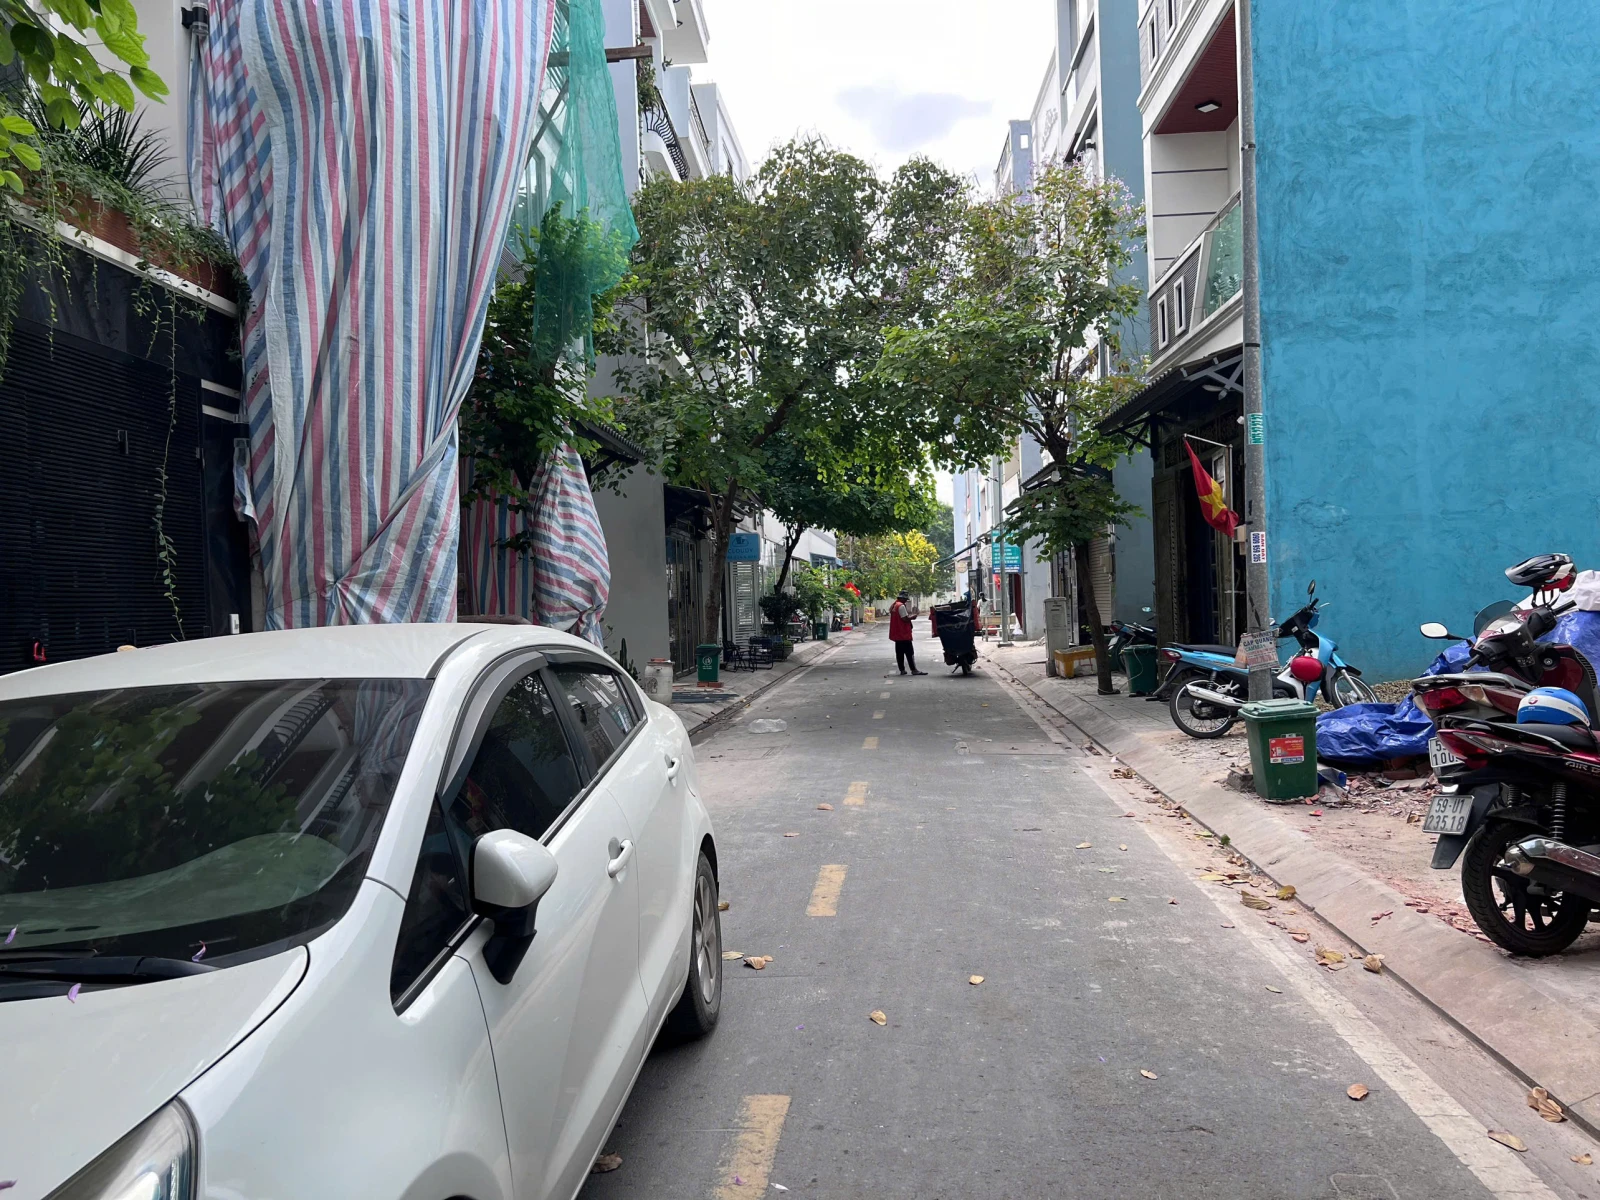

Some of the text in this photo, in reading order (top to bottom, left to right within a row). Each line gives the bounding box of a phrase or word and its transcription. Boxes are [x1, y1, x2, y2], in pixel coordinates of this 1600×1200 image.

[1565, 761, 1588, 771] AIR
[1435, 798, 1465, 814] 59-U1
[1427, 815, 1465, 831] 235.18
